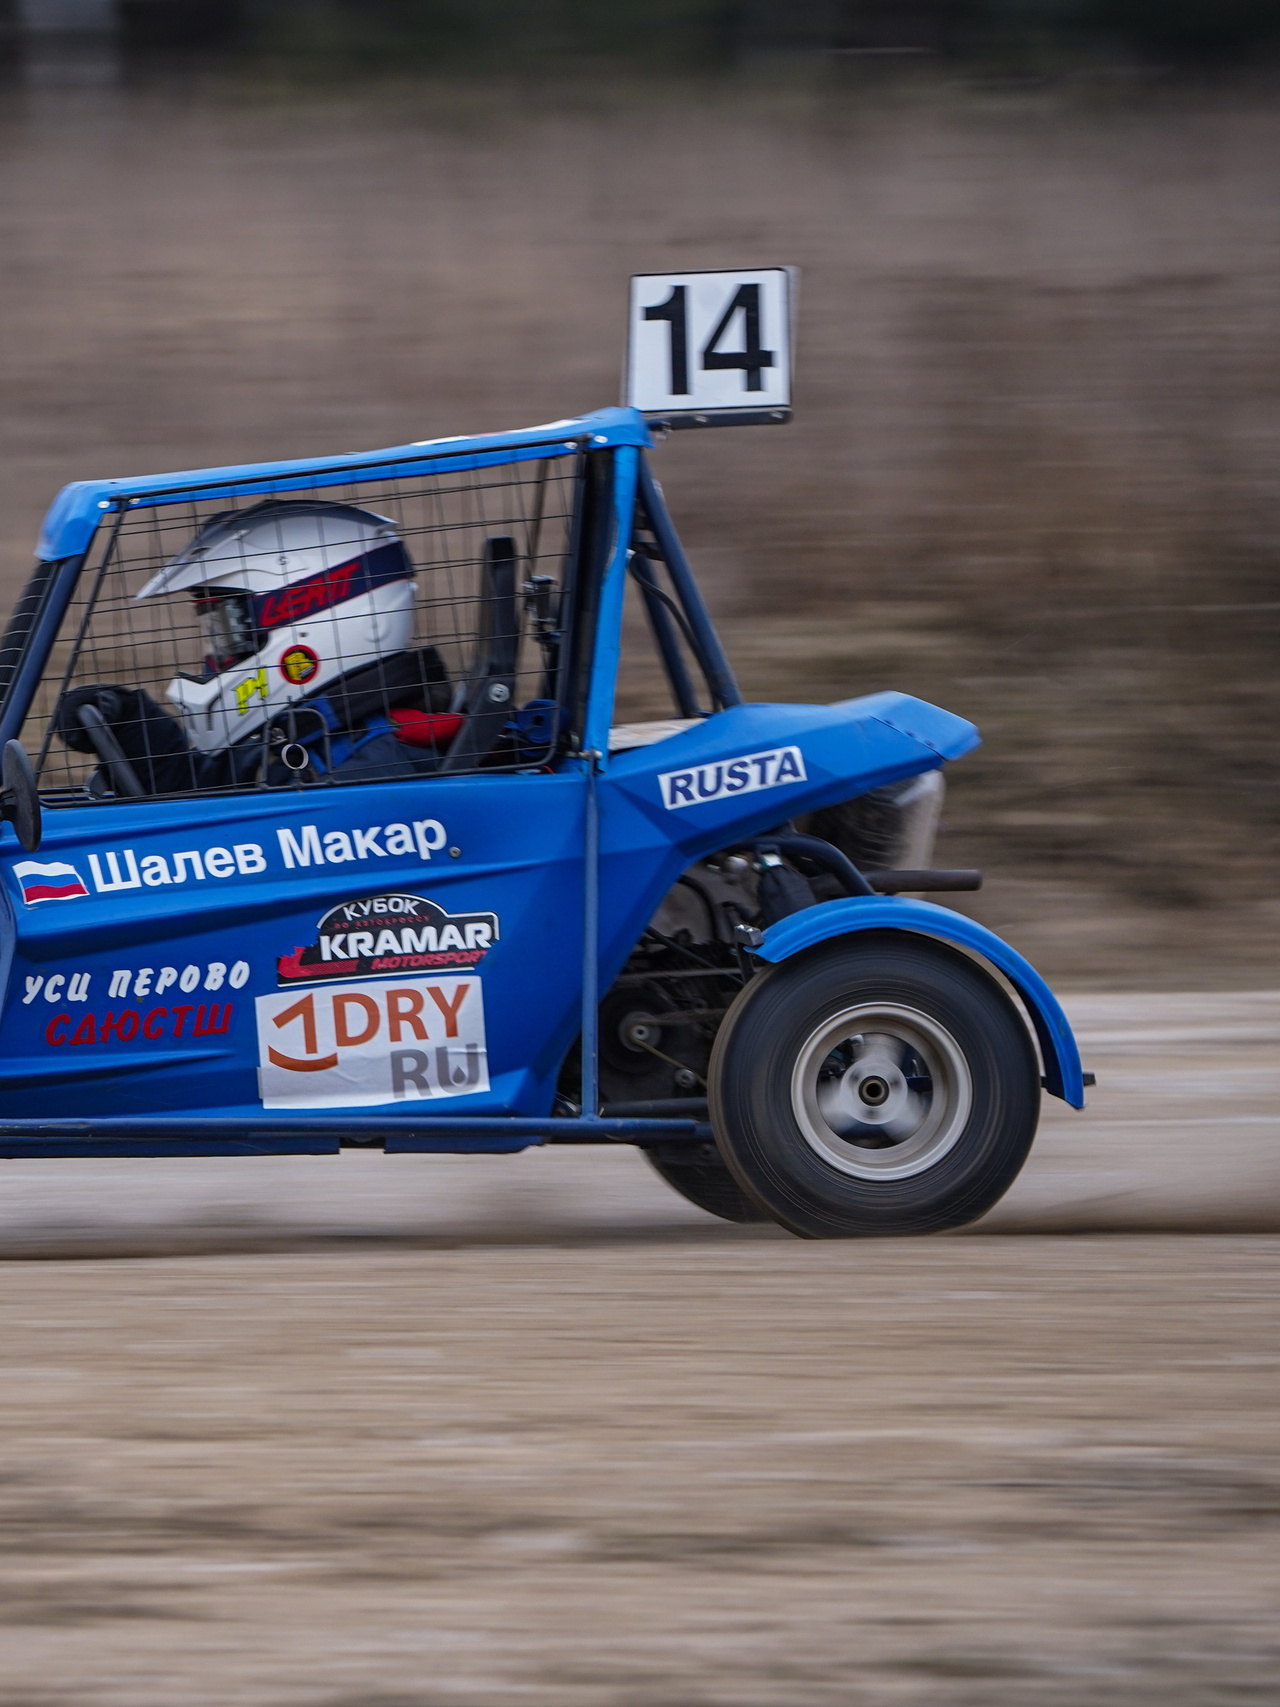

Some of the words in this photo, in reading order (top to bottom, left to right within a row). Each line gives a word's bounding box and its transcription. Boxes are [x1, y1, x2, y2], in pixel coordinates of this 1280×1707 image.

[641, 284, 777, 395] 14
[669, 752, 802, 805] RUSTA
[87, 843, 268, 892] Шалев
[276, 819, 448, 869] Макар
[342, 897, 420, 921] КУБОК
[320, 922, 493, 962] KRAMAR
[22, 972, 92, 1005] УСЦ
[108, 960, 251, 998] ПЕРОВО
[390, 1043, 481, 1100] RU
